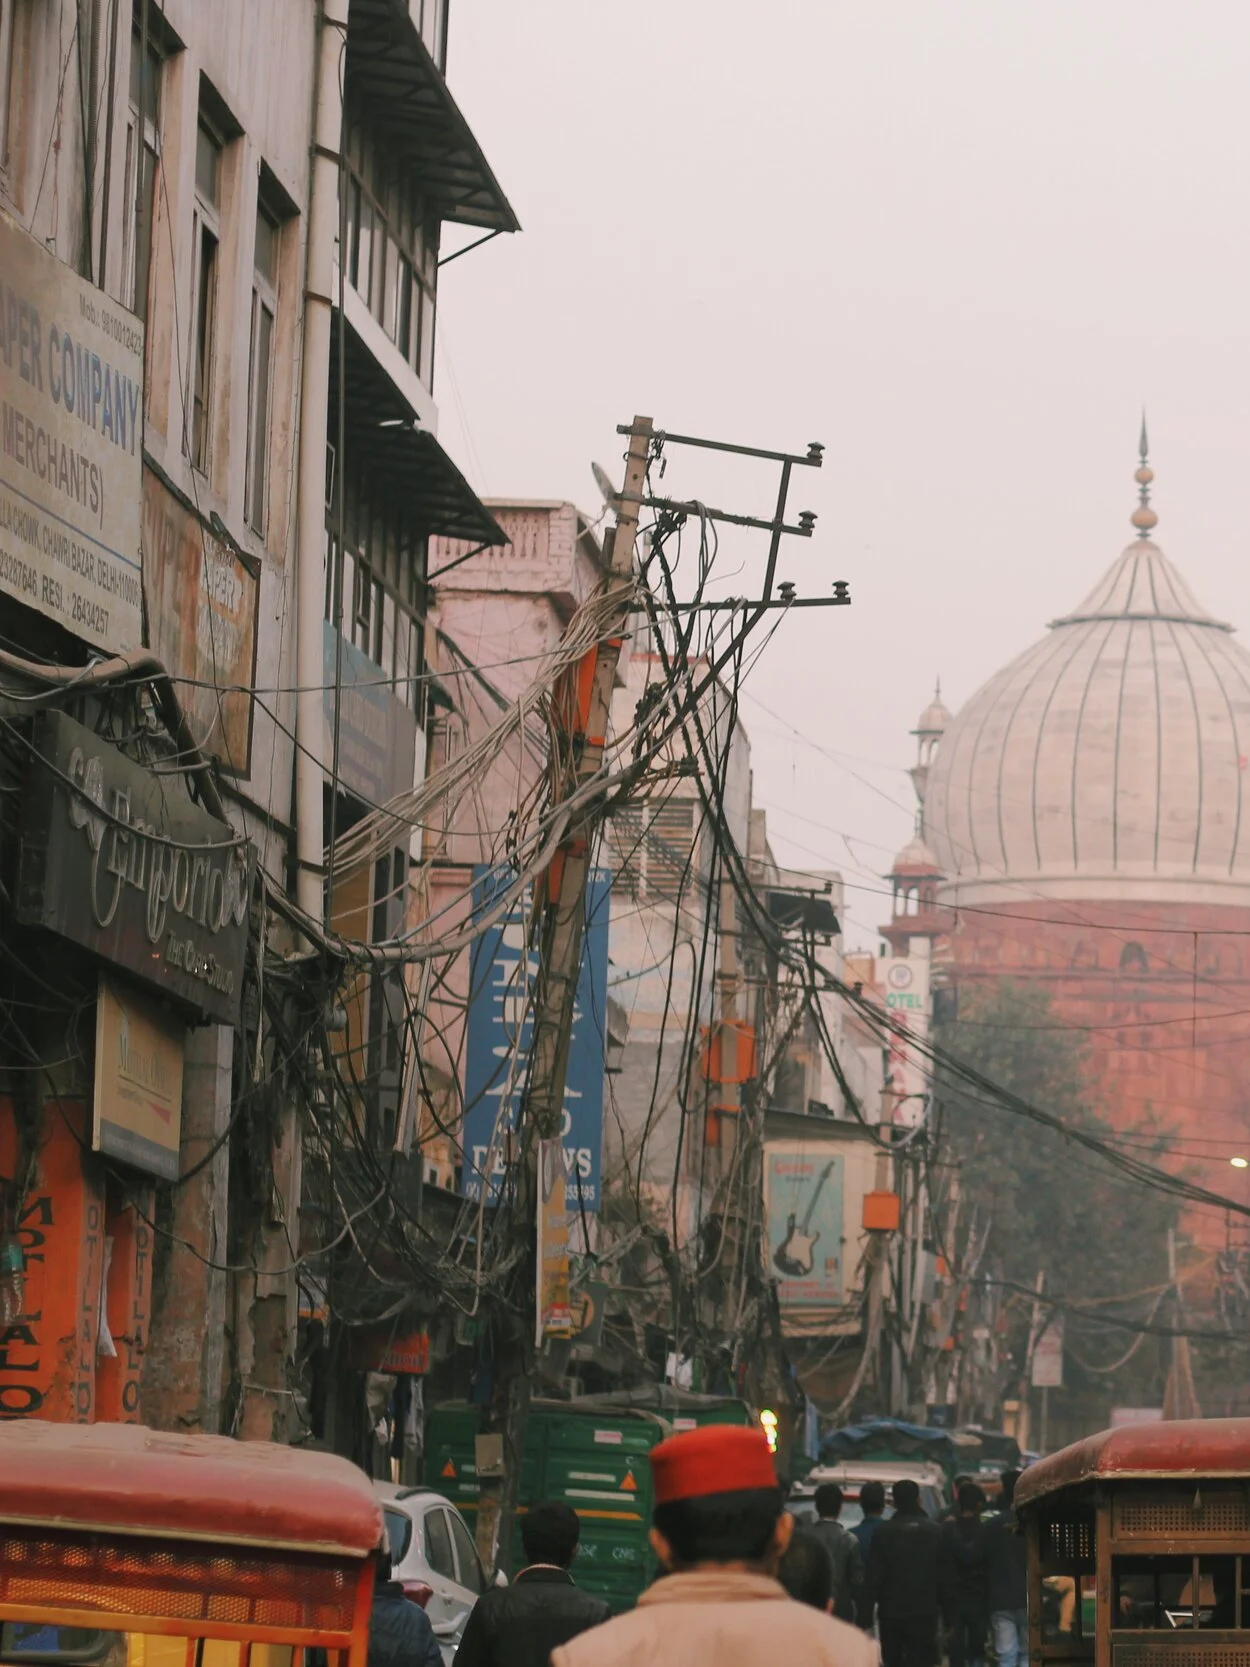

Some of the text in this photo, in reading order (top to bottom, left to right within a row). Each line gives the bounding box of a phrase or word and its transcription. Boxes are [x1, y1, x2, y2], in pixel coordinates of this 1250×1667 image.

[48, 322, 139, 457] COMPANY
[3, 401, 104, 530] MERCHANTS)
[43, 525, 70, 569] CHAWRI
